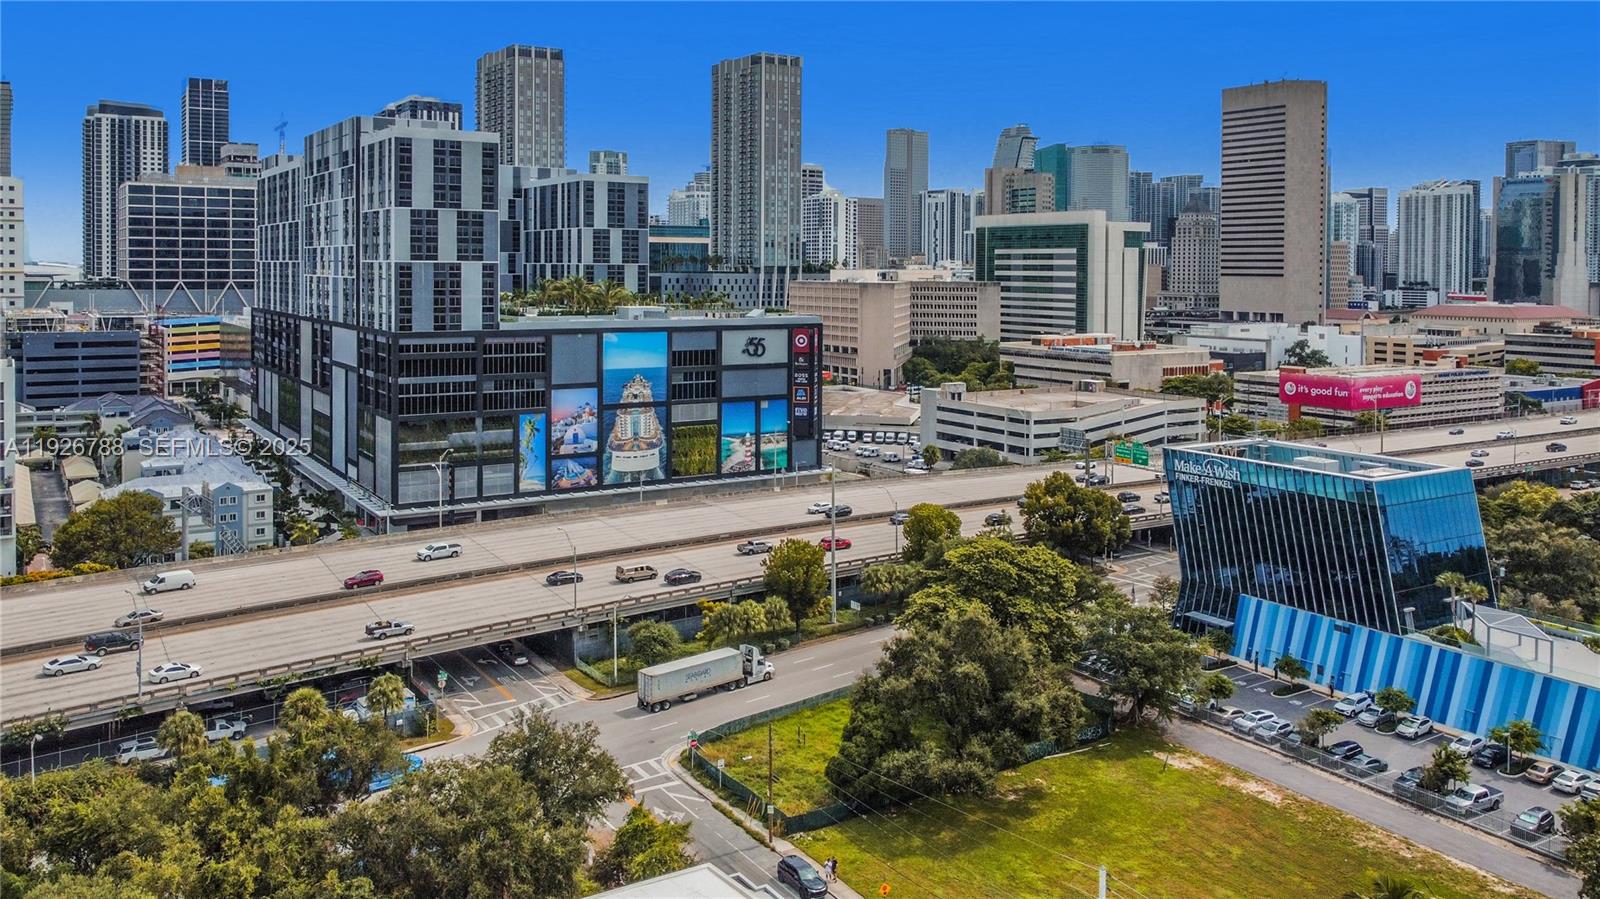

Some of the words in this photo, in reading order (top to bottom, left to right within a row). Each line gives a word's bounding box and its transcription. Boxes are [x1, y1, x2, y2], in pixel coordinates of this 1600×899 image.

[1297, 384, 1309, 393] it's
[1310, 387, 1333, 396] good
[1334, 387, 1348, 397] fun
[1373, 386, 1383, 394] play
[1175, 472, 1233, 489] FINKER-FRENKEL
